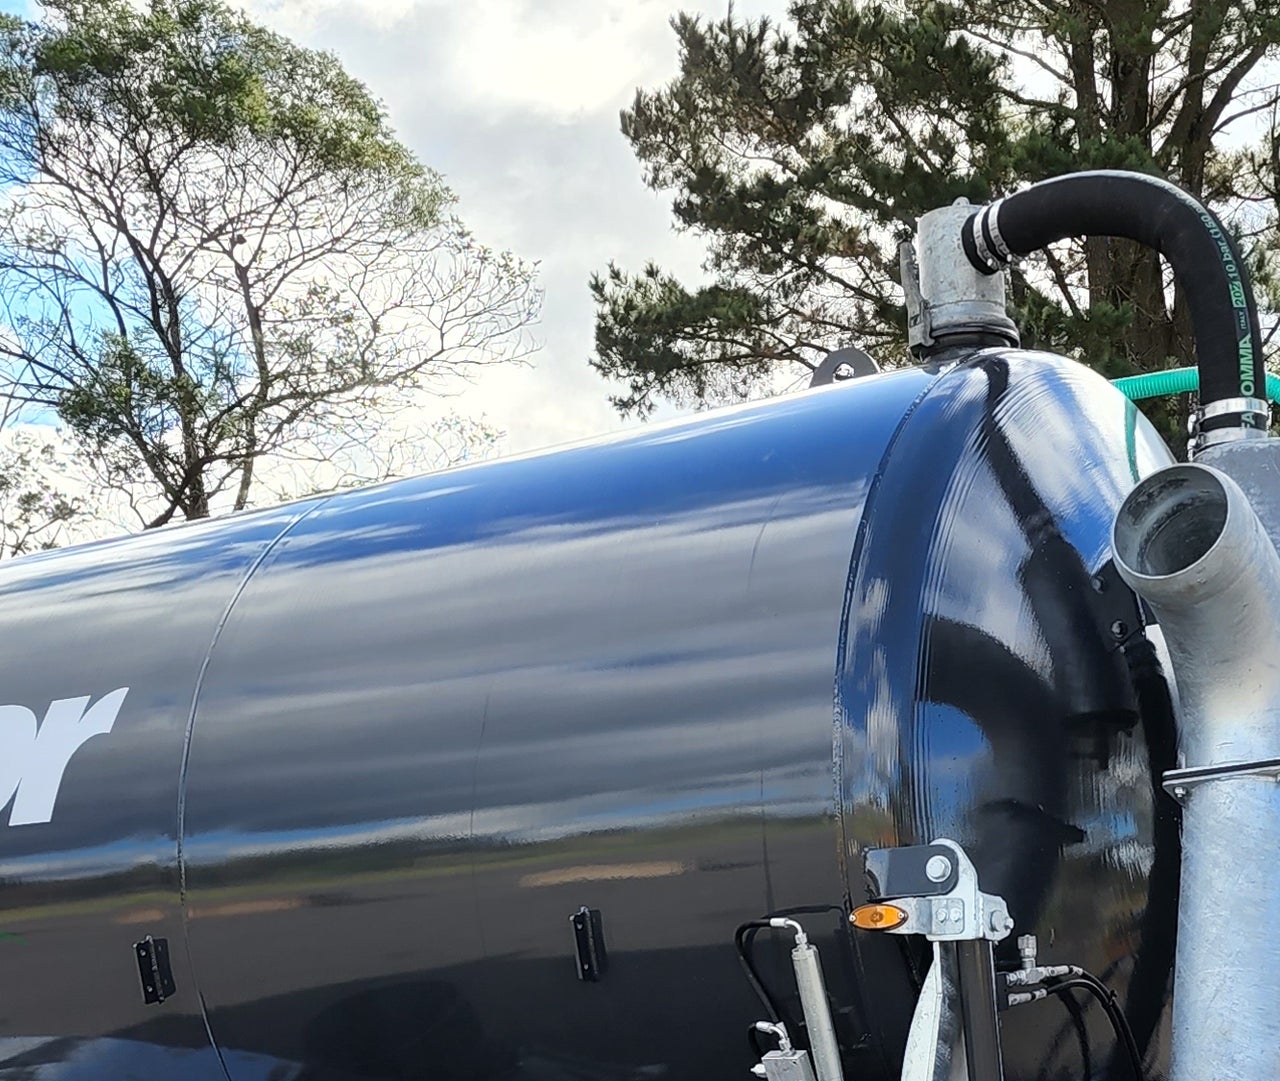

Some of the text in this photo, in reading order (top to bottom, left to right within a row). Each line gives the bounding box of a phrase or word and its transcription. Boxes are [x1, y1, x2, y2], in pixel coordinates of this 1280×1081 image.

[1201, 215, 1222, 238] (150
[1218, 240, 1234, 262] bar
[1225, 263, 1239, 279] 10
[1231, 283, 1245, 306] 202
[1239, 311, 1248, 329] ITALY
